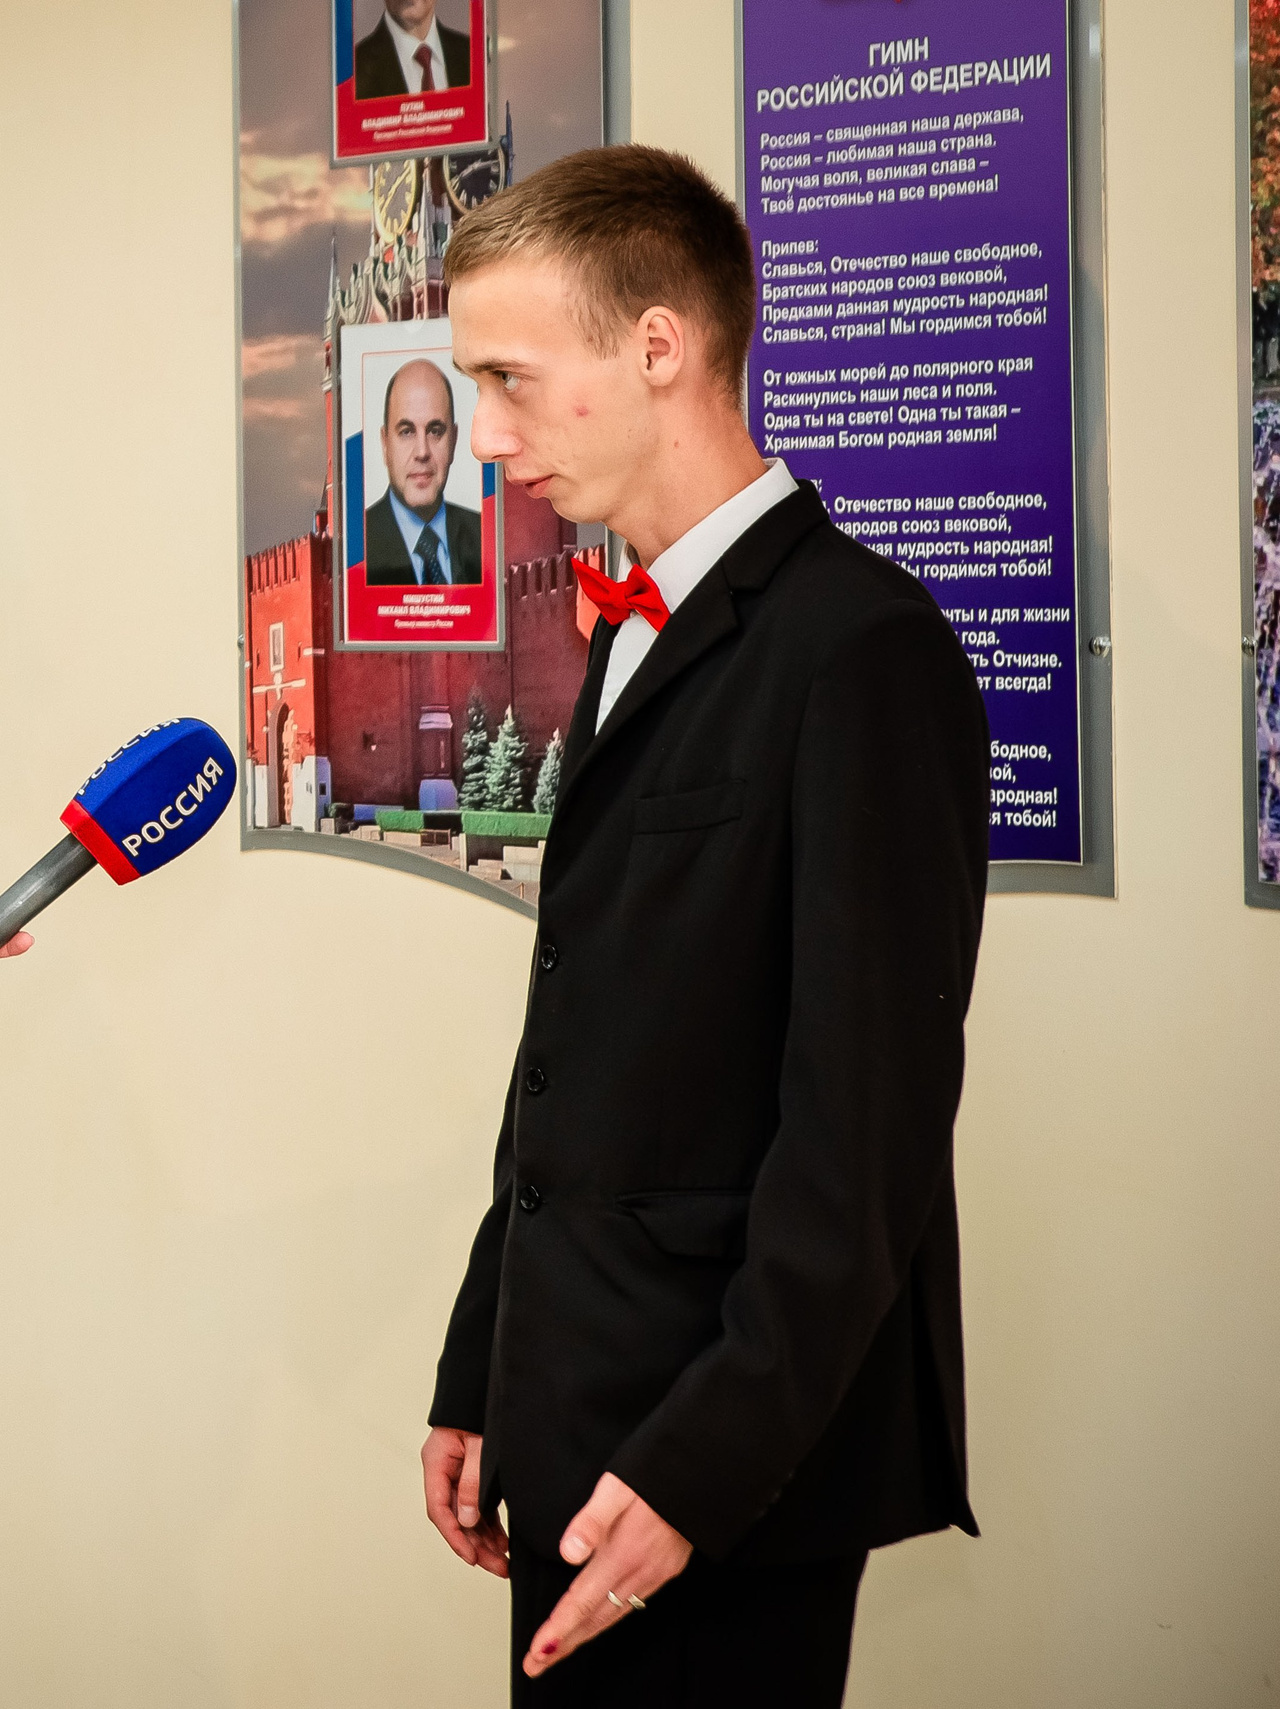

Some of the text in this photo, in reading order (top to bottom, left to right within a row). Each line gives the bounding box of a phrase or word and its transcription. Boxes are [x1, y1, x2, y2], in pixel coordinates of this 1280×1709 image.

[869, 36, 930, 69] ГИМН
[757, 52, 1052, 114] РОССИЙСКОЙ ФЕДЕРАЦИИ
[760, 131, 812, 151] Россия
[825, 120, 908, 144] священная
[911, 115, 951, 134] наша
[953, 107, 1025, 132] держава,
[760, 153, 812, 172] Россия
[825, 143, 895, 166] любимая
[897, 139, 938, 158] наша
[761, 174, 821, 194] Могучая
[823, 169, 864, 189] воля,
[866, 162, 928, 184] великая
[931, 157, 977, 177] слава
[760, 173, 1000, 216] Твоё достоянье на все времена!
[761, 239, 820, 261] Припев:
[761, 242, 1043, 281] Славься, Отечество наше свободное,
[762, 265, 1008, 302] Братских народов союз вековой,
[762, 283, 1049, 324] Предками данная мудрость народная!
[762, 306, 1048, 345] Славься, страна! Мы гордимся тобой!
[763, 356, 1034, 388] От южных морей до полярного края
[763, 390, 858, 409] Раскинулись
[859, 387, 900, 404] наши
[902, 385, 939, 402] леса
[941, 384, 952, 400] и
[763, 412, 802, 432] Одна
[803, 408, 825, 429] ты
[827, 412, 846, 428] на
[847, 406, 894, 427] свете!
[897, 405, 938, 426] Одна
[939, 406, 962, 422] ты
[965, 403, 1008, 421] такая
[763, 423, 998, 453] Хранимая Богом родная земля!
[833, 495, 913, 515] Отечество
[915, 496, 956, 512] наше
[958, 490, 1048, 512] свободное,
[901, 519, 942, 535] союз
[944, 513, 1013, 535] вековой,
[897, 541, 971, 560] мудрость
[973, 535, 1054, 558] народная!
[923, 565, 998, 582] гордимся
[999, 558, 1052, 578] тобой!
[978, 608, 988, 623] и
[990, 608, 1021, 626] для
[1023, 607, 1071, 623] жизни
[995, 672, 1052, 694] всегда!
[121, 756, 225, 858] РОССИЯ
[990, 786, 1058, 808] ародная!
[1004, 808, 1058, 829] тобой!
